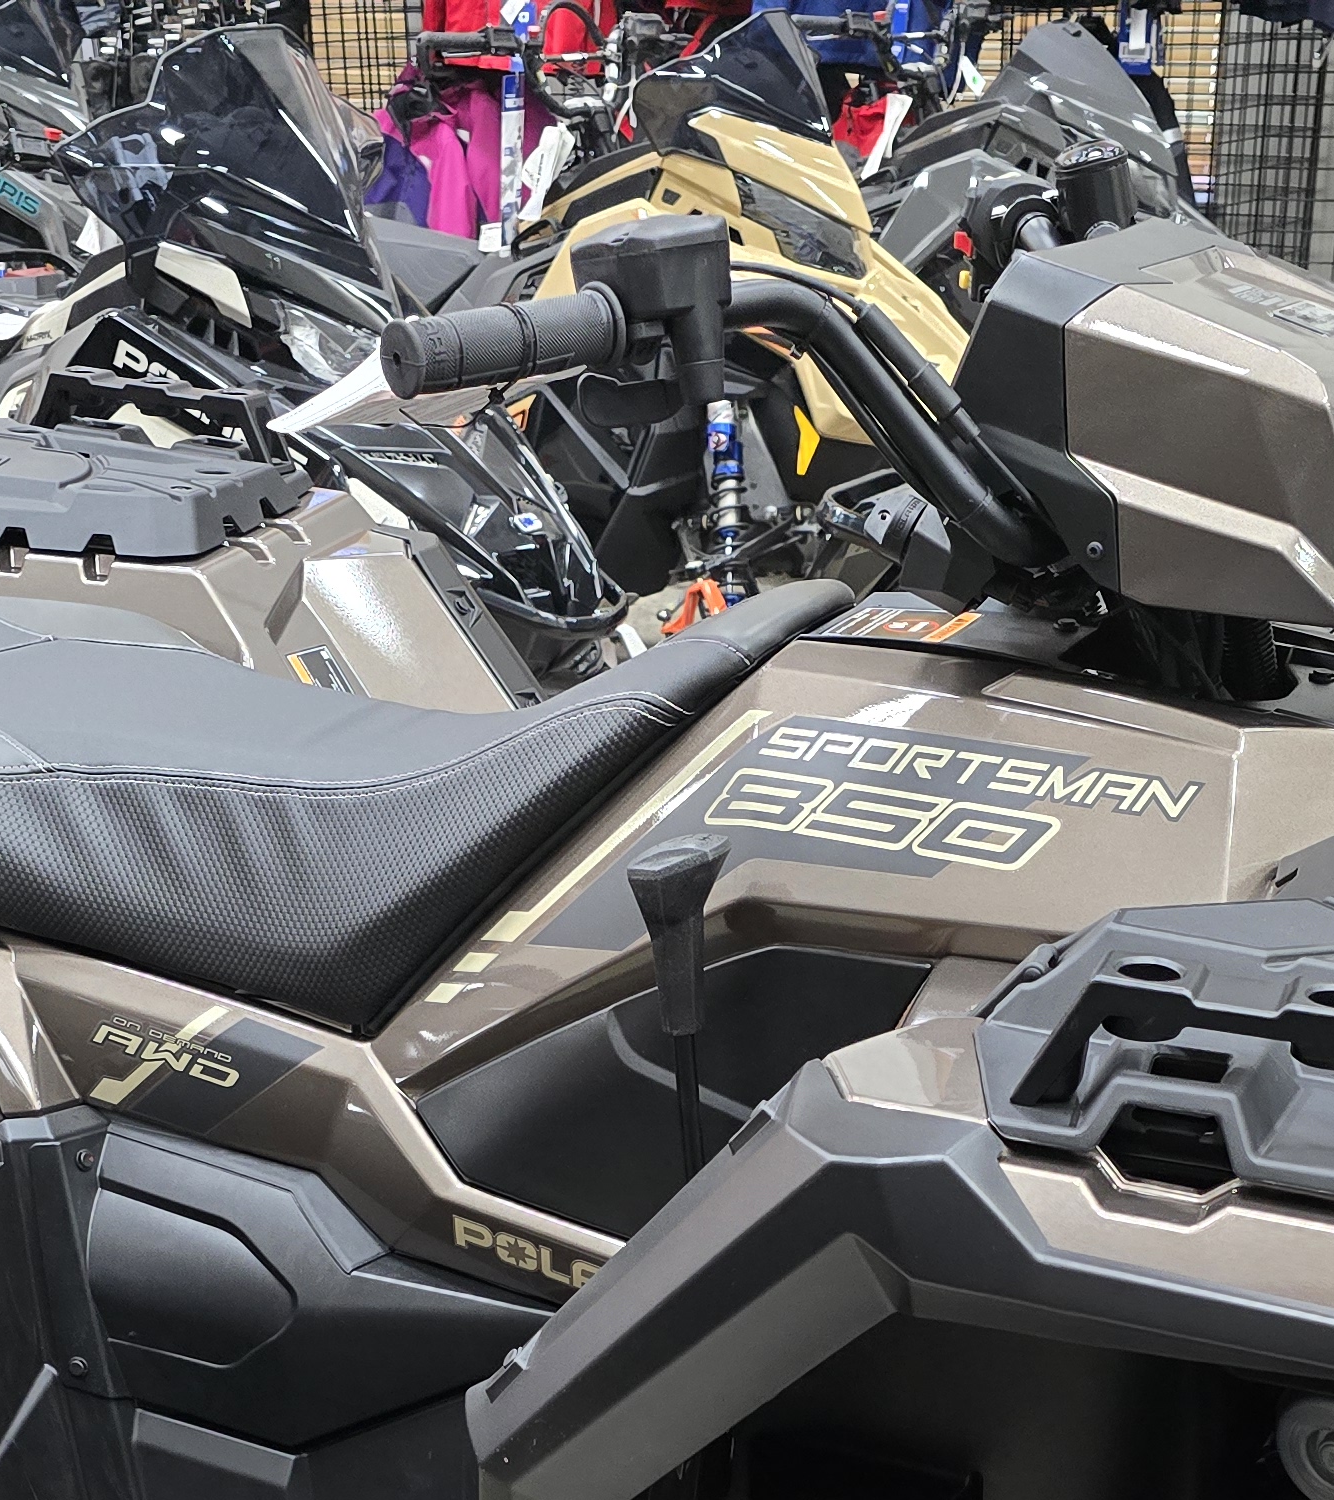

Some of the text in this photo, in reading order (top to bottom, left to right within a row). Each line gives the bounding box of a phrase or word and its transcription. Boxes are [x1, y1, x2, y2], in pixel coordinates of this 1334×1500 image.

[759, 727, 1203, 818] SPORTSMAN
[703, 767, 1063, 871] 850
[92, 1024, 240, 1088] AWD
[112, 1016, 232, 1063] ON DEMAND
